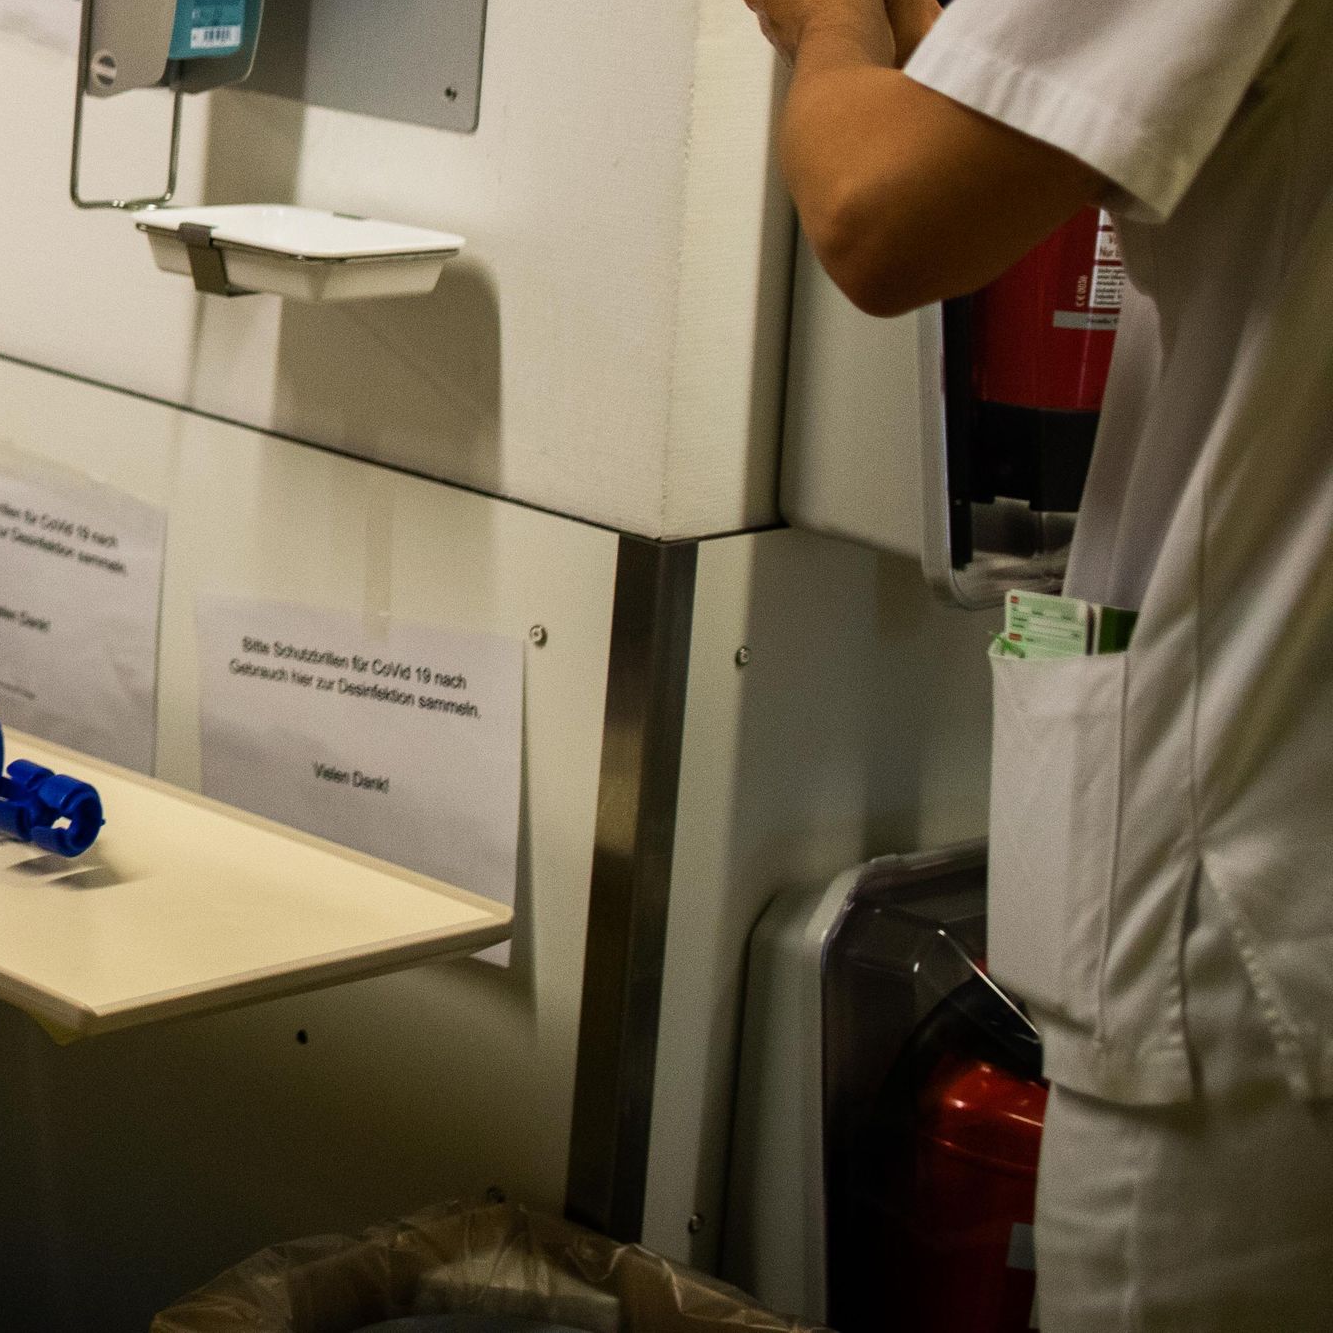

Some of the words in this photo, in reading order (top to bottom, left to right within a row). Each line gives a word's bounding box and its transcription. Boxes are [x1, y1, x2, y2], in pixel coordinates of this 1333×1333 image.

[10, 525, 76, 557] Desinfektion
[76, 523, 91, 542] 19
[92, 531, 119, 549] nach
[241, 634, 270, 655] Bitte
[273, 640, 350, 671] Schutzbrillen
[351, 653, 370, 674] für
[371, 657, 412, 682] CoVid
[414, 665, 432, 685] 19
[434, 670, 467, 691] nach
[229, 657, 289, 684] Gebrauch
[290, 668, 314, 688] hier
[315, 677, 336, 692] zur
[337, 676, 416, 708] Desinfektion
[417, 694, 482, 720] sammeln.
[313, 760, 351, 785] Vielen
